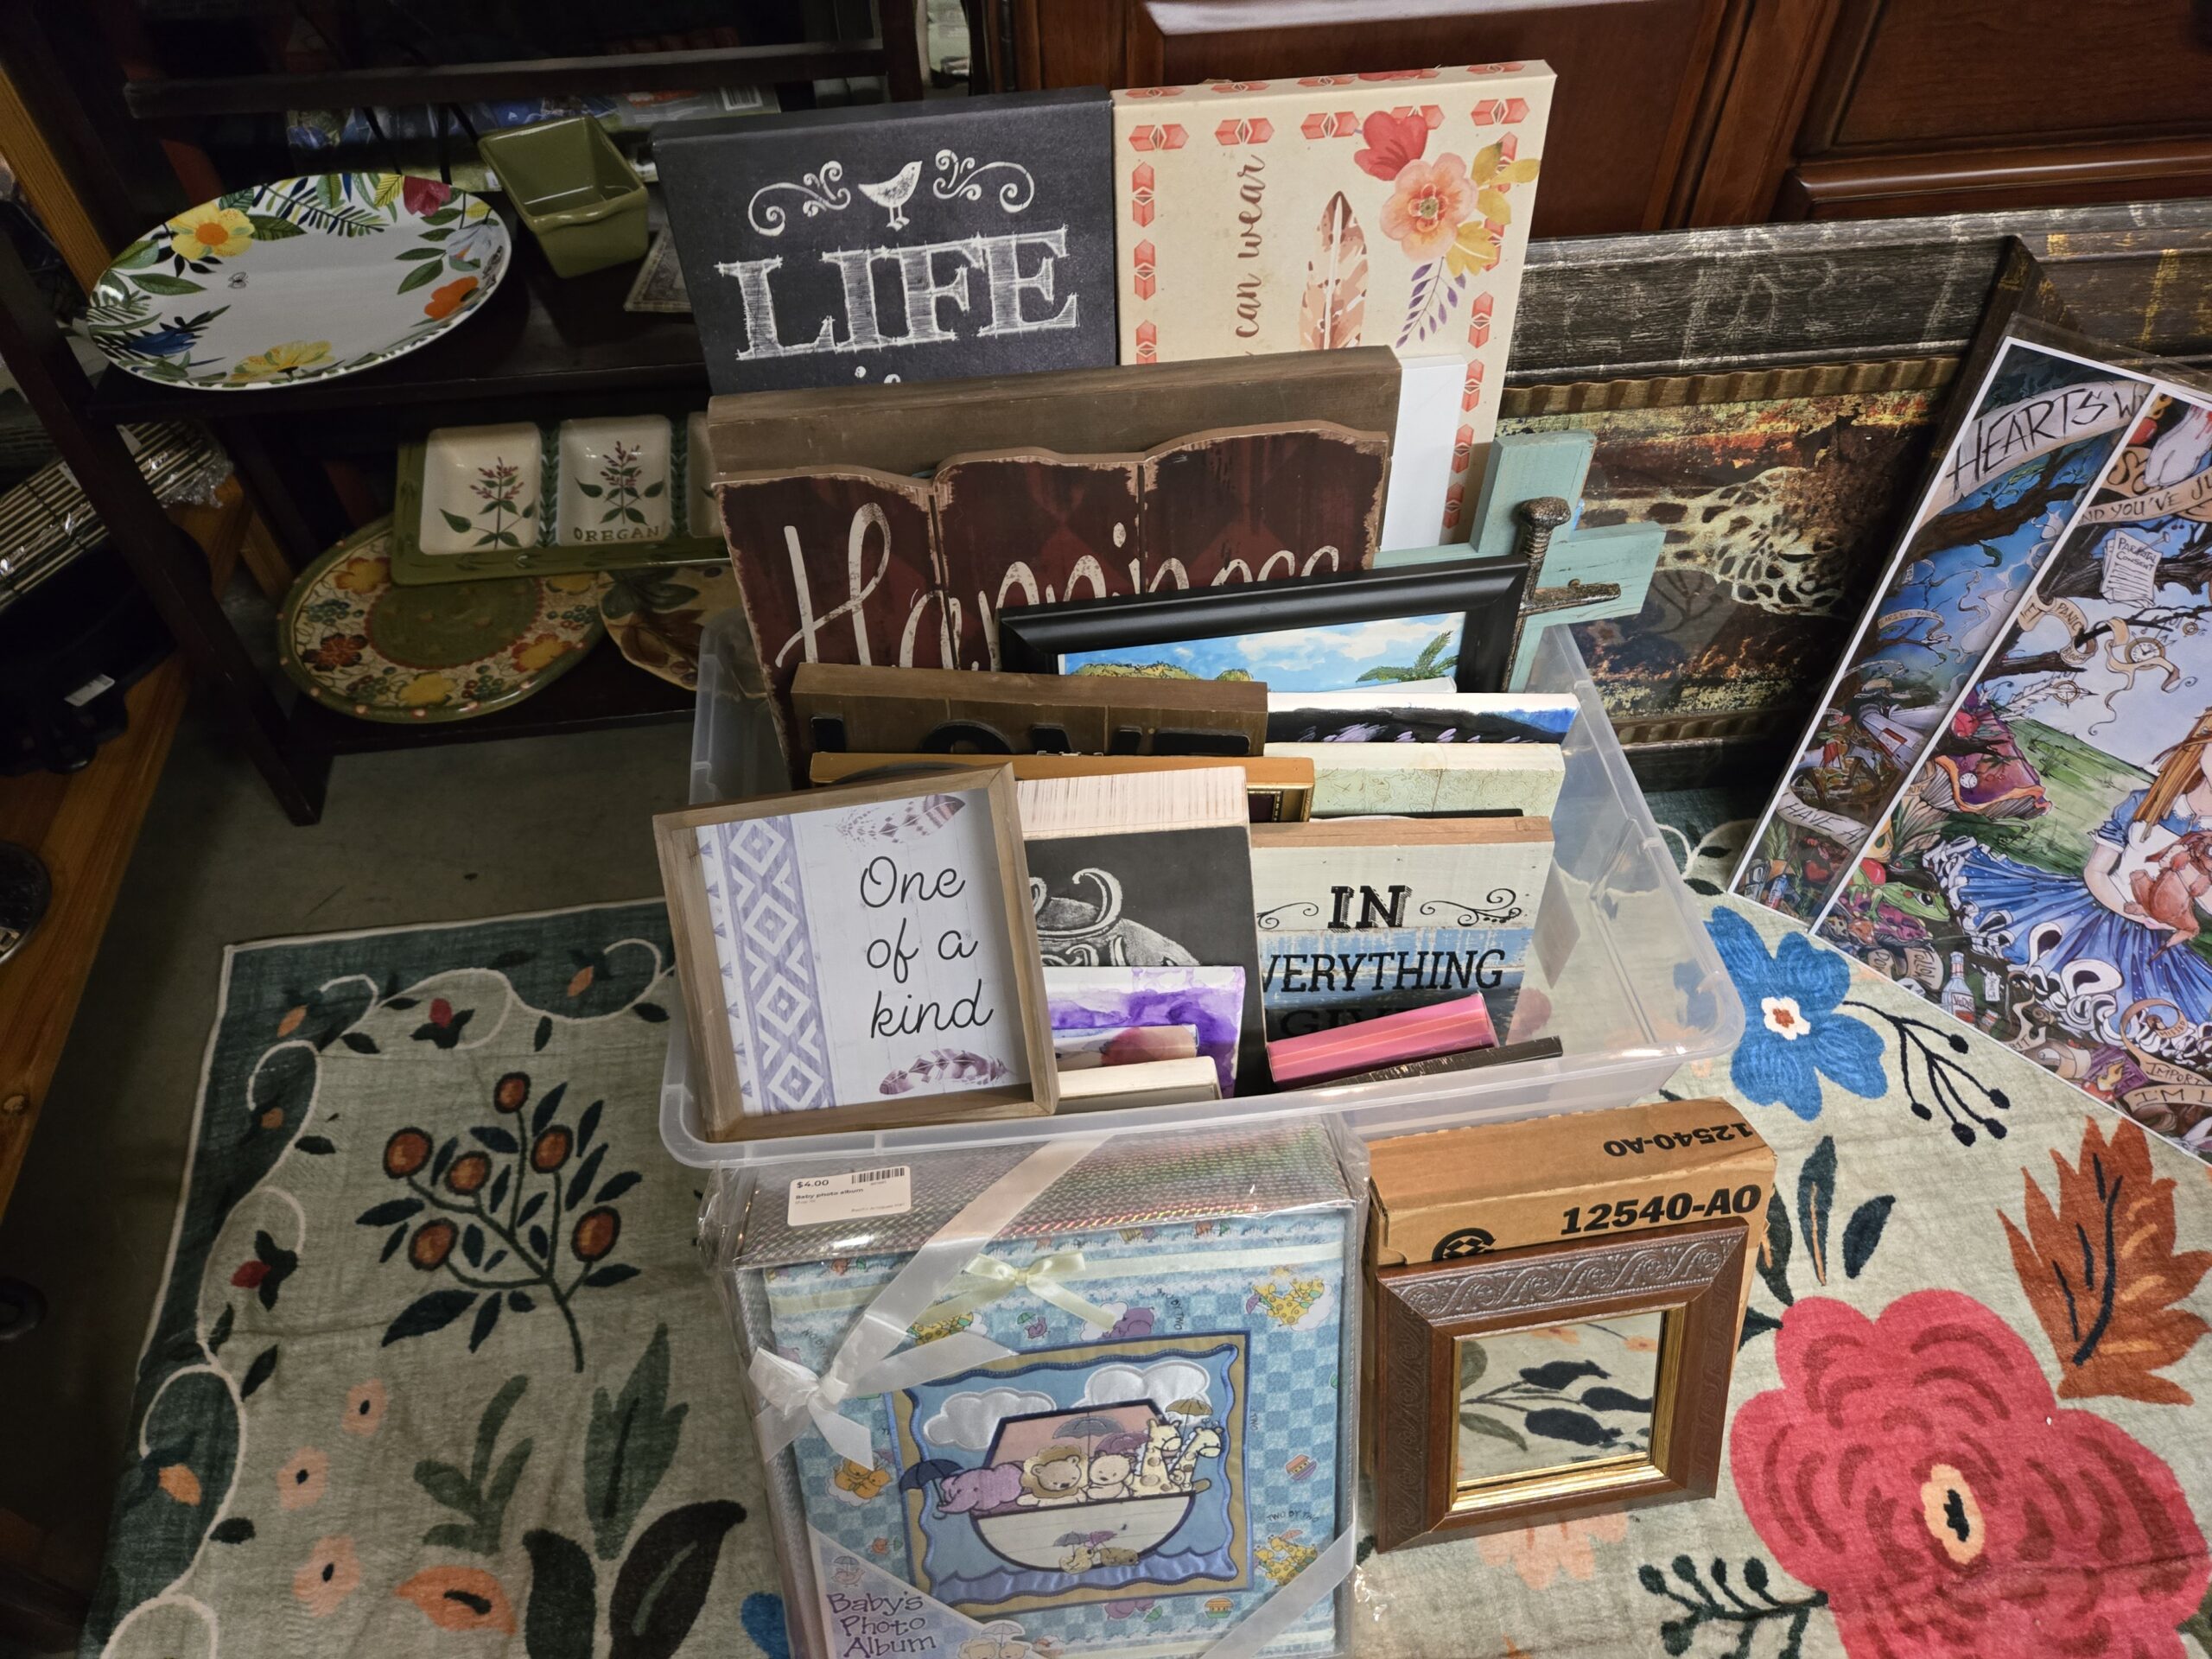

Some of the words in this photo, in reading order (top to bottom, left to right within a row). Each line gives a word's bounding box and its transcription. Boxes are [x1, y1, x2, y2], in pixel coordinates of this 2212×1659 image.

[1236, 154, 1267, 259] wear
[715, 225, 1079, 361] LIFE
[1235, 272, 1262, 338] can
[1946, 388, 2108, 494] HEARTS
[2111, 491, 2179, 518] YOU'VE
[2055, 602, 2083, 631] PANIC
[1783, 802, 1844, 833] HAVE
[860, 855, 966, 908] One
[1327, 885, 1412, 934] IN
[866, 918, 919, 984] of
[938, 930, 978, 961] a
[1262, 949, 1506, 994] VERYTHING
[870, 979, 994, 1039] kind
[797, 1179, 830, 1189] $4.00
[817, 1191, 838, 1199] photo
[826, 1591, 924, 1617] Baby's
[840, 1615, 926, 1637] Photo
[843, 1634, 937, 1659] Album
